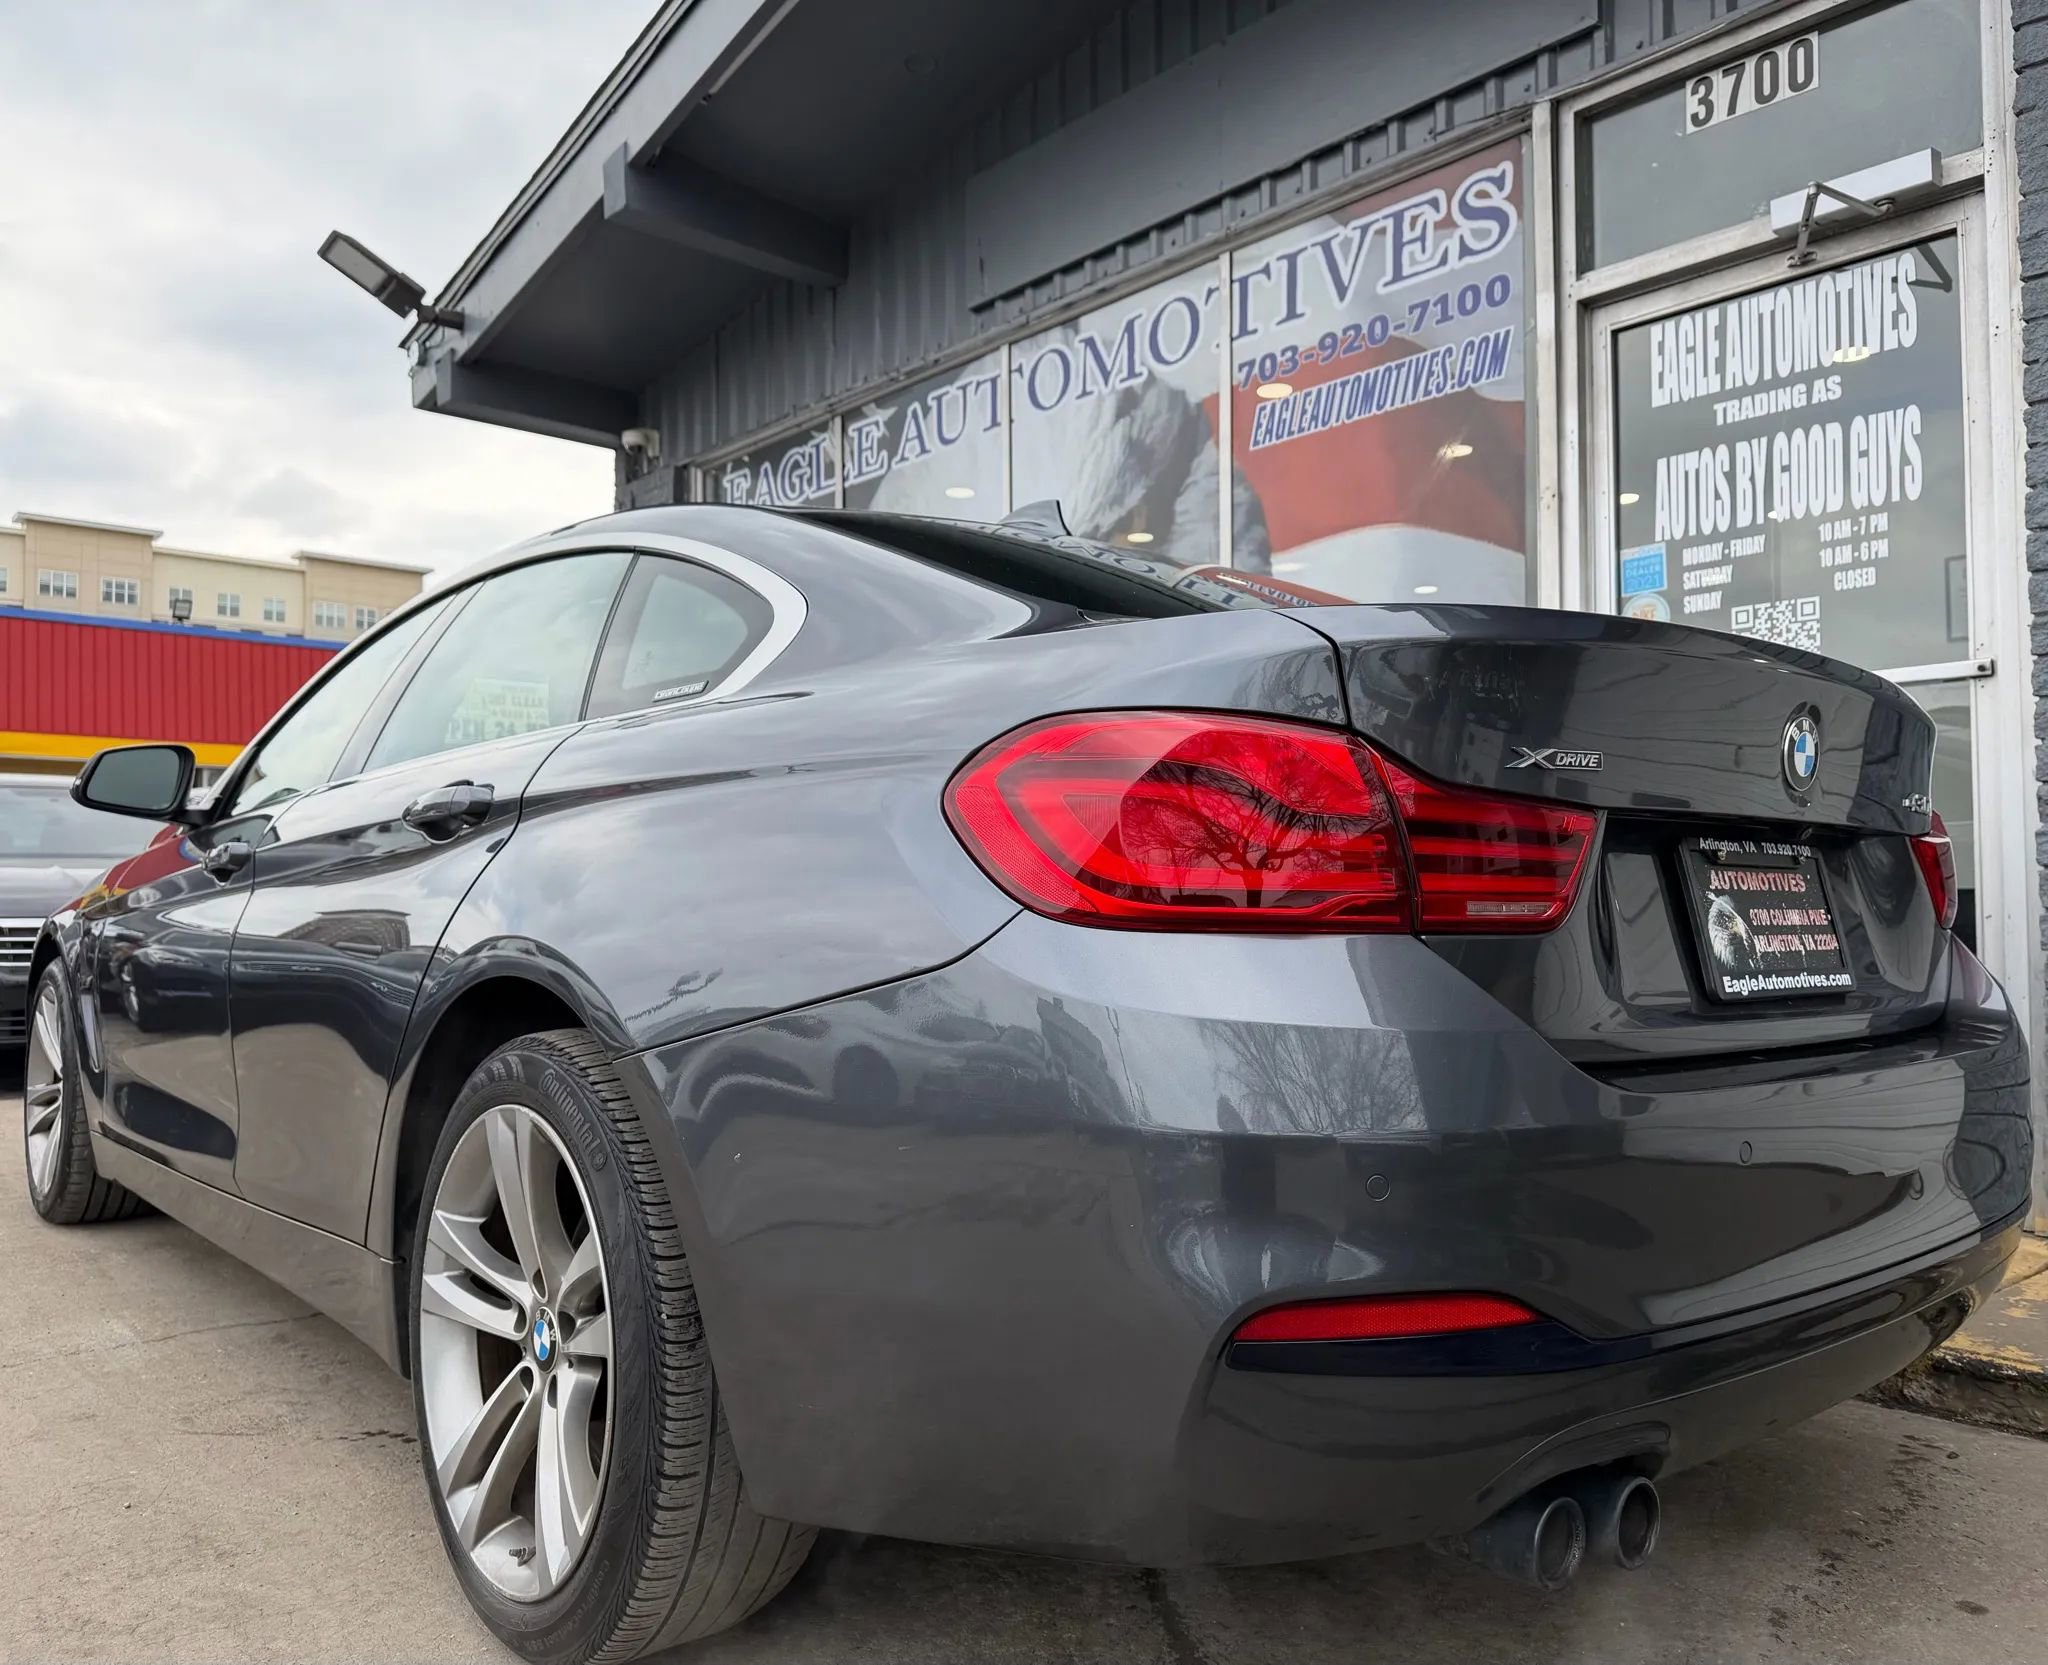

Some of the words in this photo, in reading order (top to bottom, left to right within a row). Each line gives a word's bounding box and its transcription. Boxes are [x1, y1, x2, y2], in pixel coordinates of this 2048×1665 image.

[1690, 37, 1814, 128] 3700
[724, 414, 888, 505] EAGLE
[891, 160, 1519, 468] AUTOMOTIVES
[1237, 273, 1512, 391] 703-920-7100
[1650, 306, 1721, 408] EAGLE
[1725, 252, 1918, 390] AUTOMOTIVES
[1249, 324, 1514, 450] EAGLEAUTOMOTIVES.COM
[1713, 383, 1808, 426] TRADING
[1812, 375, 1842, 404] AS
[1655, 443, 1732, 542] AUTOS
[1735, 436, 1768, 528] BY
[1772, 421, 1844, 523] GOOD
[1850, 404, 1923, 510] GUYS
[1818, 523, 1833, 542] 10
[1832, 518, 1852, 540] AM
[1859, 515, 1867, 536] 7
[1870, 511, 1888, 534] PM
[1682, 541, 1724, 567] MONDAY
[1730, 534, 1766, 558] FRIDAY
[1819, 548, 1833, 568] 10
[1832, 543, 1852, 565] AM
[1861, 541, 1869, 561] 6
[1870, 538, 1889, 560] PM
[1683, 565, 1733, 591] SATURDAY
[1833, 566, 1876, 592] CLOSED
[1684, 590, 1722, 615] SUNDAY
[1699, 837, 1743, 855] Arlington,
[1743, 840, 1757, 853] VA
[1761, 842, 1811, 857] 703.920.7100
[1709, 869, 1807, 893] AUTOMOTIVES
[1769, 908, 1809, 926] COLUMBIA
[1810, 908, 1829, 926] PIKE
[1805, 934, 1816, 951] VA
[1722, 972, 1853, 997] EagleAutomotives.com
[539, 1069, 601, 1149] Continental
[535, 1309, 557, 1341] BMW
